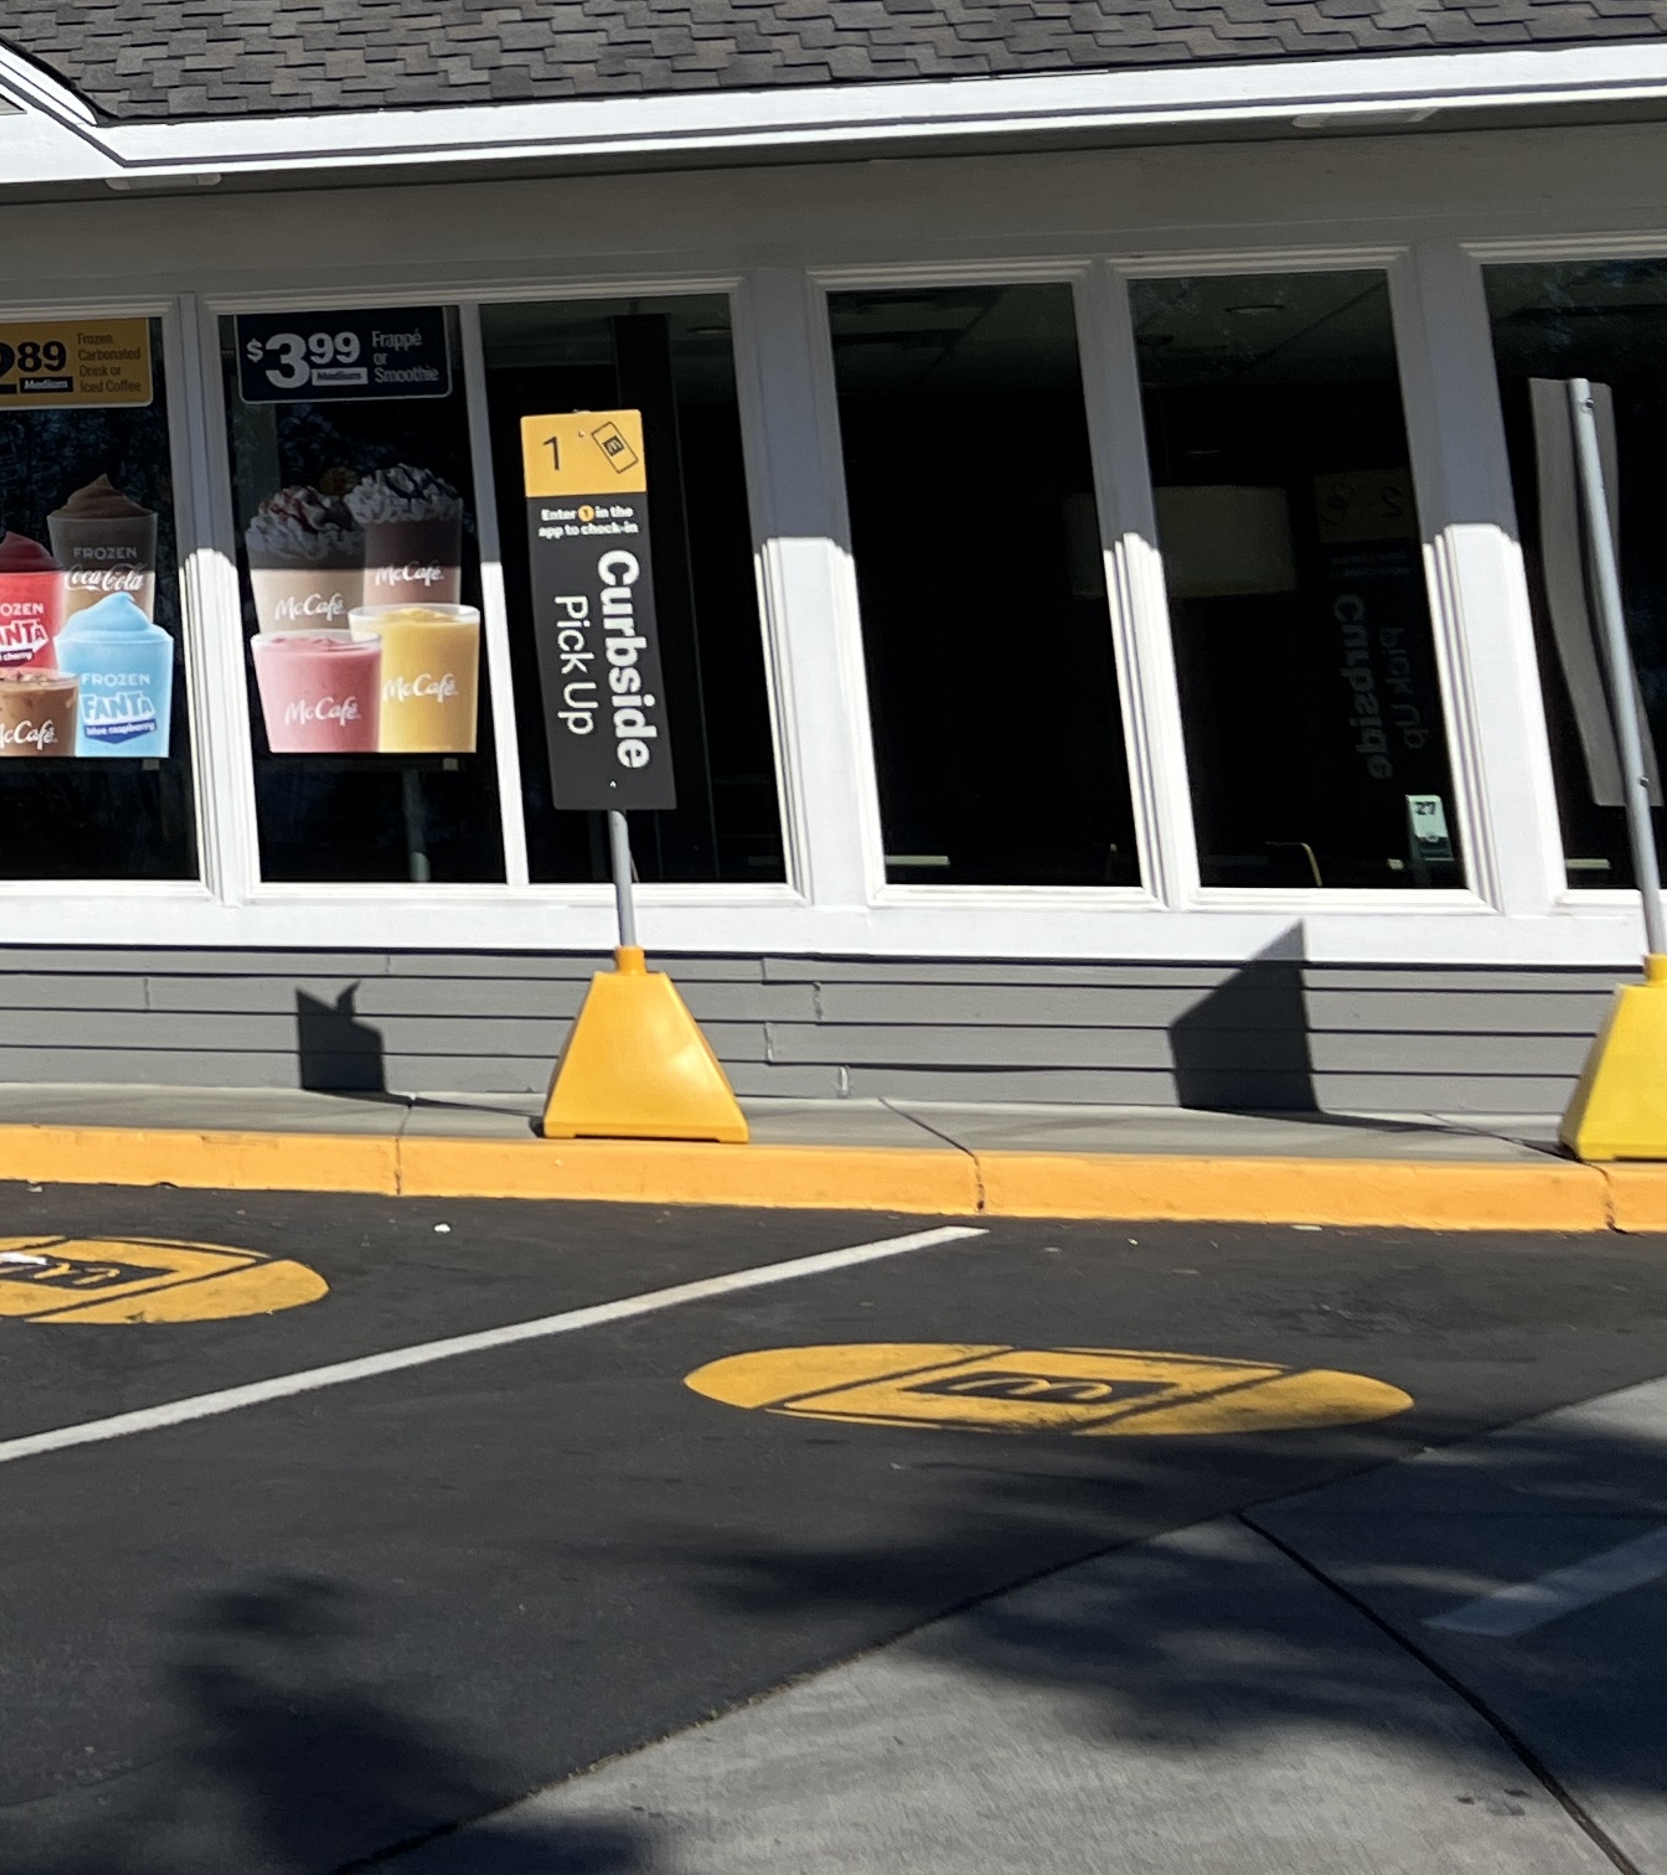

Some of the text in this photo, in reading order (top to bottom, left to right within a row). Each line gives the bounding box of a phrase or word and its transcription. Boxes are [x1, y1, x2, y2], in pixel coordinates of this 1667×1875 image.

[371, 327, 423, 351] Frappé
[78, 347, 141, 361] Carbonated
[372, 352, 388, 366] or
[79, 364, 122, 377] Drink or
[374, 364, 439, 383] Smoothie
[105, 379, 141, 393] Coffee
[542, 436, 560, 471] 1
[541, 508, 577, 521] Enter
[595, 506, 609, 518] in
[610, 506, 634, 518] the
[538, 521, 639, 539] app to check-in
[73, 546, 138, 559] FROZEN
[554, 595, 599, 735] Pick Up
[597, 550, 658, 769] Curbside
[81, 673, 151, 688] FROZEN
[382, 672, 457, 703] McCafé
[80, 691, 156, 722] FANTA
[284, 696, 361, 726] McCafé
